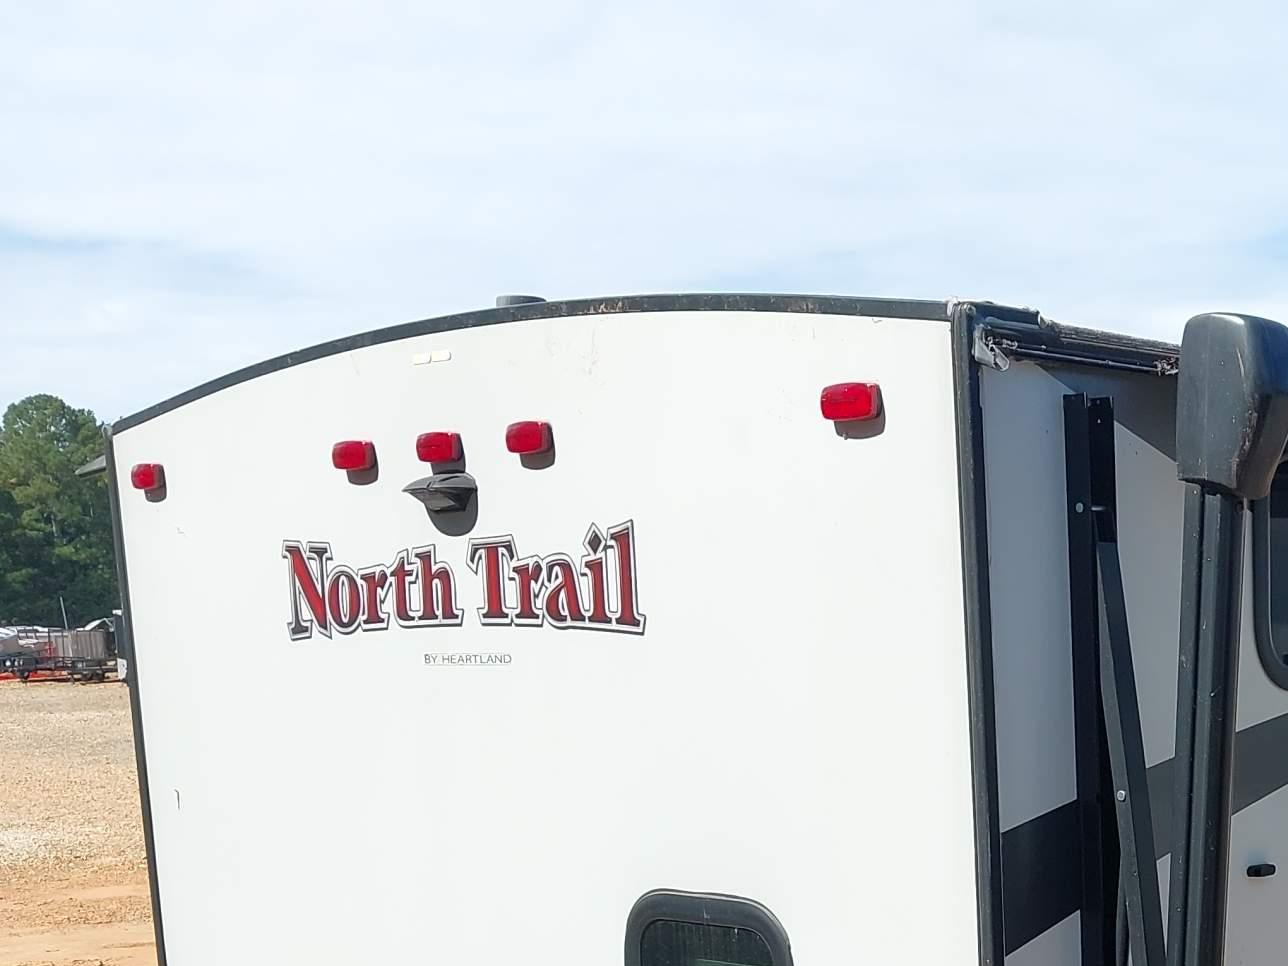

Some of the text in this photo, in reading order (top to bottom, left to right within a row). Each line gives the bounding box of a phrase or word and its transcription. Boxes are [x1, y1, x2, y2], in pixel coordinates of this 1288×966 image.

[281, 518, 647, 642] North Trail
[423, 653, 513, 665] BY HEARTLAND
